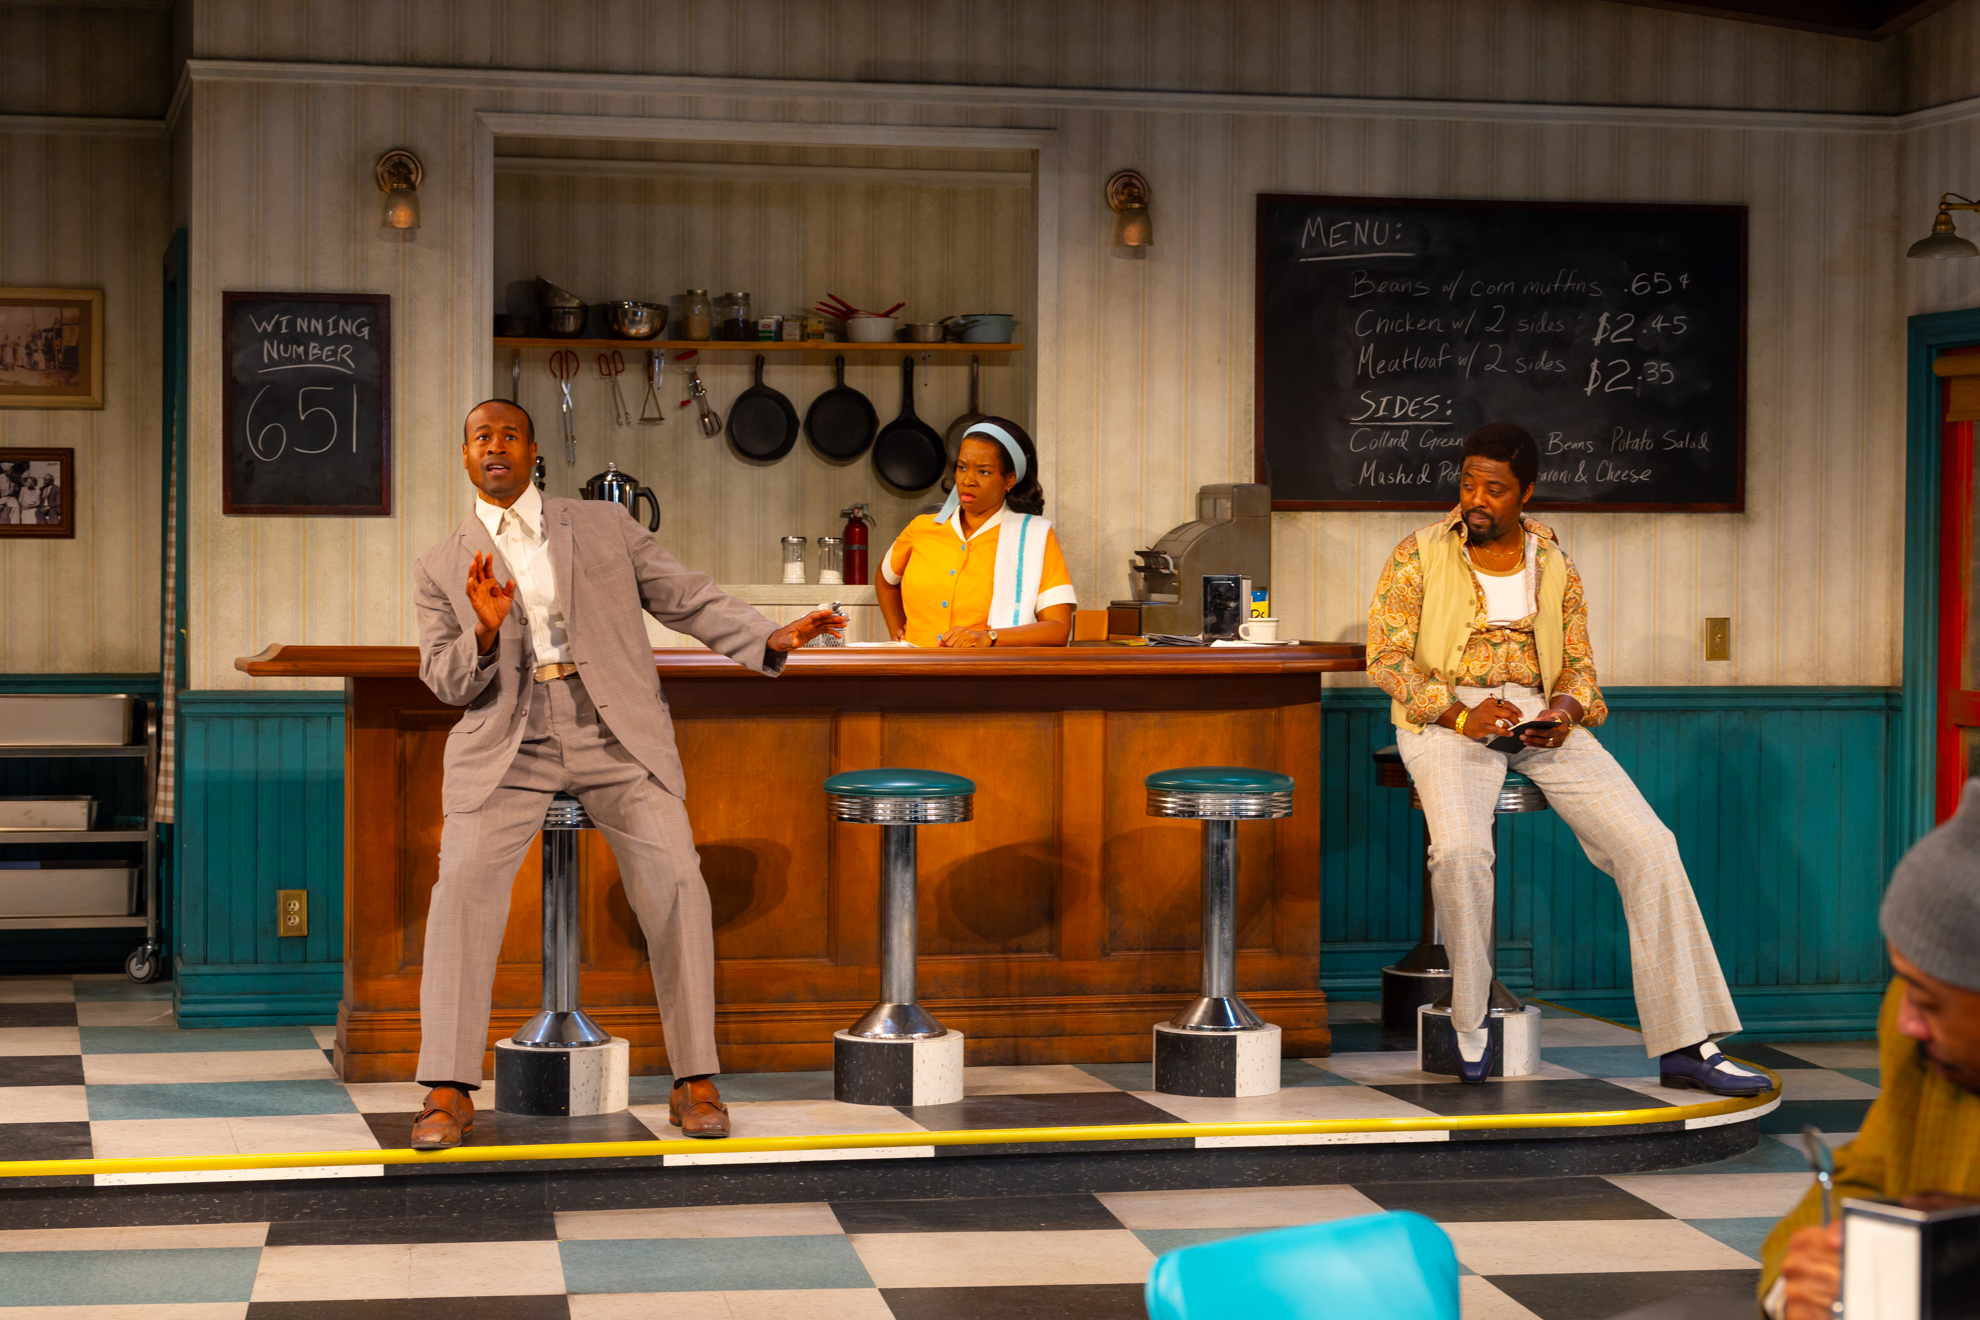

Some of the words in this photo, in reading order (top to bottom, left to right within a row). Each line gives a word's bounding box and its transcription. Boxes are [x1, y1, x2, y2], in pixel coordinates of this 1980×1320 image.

[1301, 215, 1403, 249] MENU:
[1348, 269, 1430, 299] Beans
[1441, 269, 1465, 301] w/
[1523, 268, 1603, 297] muffins
[248, 313, 370, 341] WINNING
[1354, 308, 1444, 338] Chicken
[1451, 308, 1477, 335] w/
[1484, 304, 1506, 333] 2
[1517, 310, 1565, 333] sides
[1591, 311, 1689, 347] $2.45
[262, 338, 356, 369] NUMBER
[1356, 342, 1452, 379] Meatloaf
[1457, 340, 1481, 380] w/
[1483, 343, 1507, 373] 2
[1514, 350, 1567, 374] sides
[1583, 357, 1675, 397] $2.35
[1350, 390, 1453, 421] SIDES:
[245, 382, 358, 462] 651
[1349, 427, 1409, 453] Collard
[1418, 428, 1467, 450] Green
[1544, 430, 1594, 455] Beans
[1610, 425, 1654, 453] Potato
[1661, 429, 1710, 452] Salad
[1358, 458, 1432, 487] Mashed
[1574, 459, 1589, 484] &
[1595, 459, 1652, 483] Cheese
